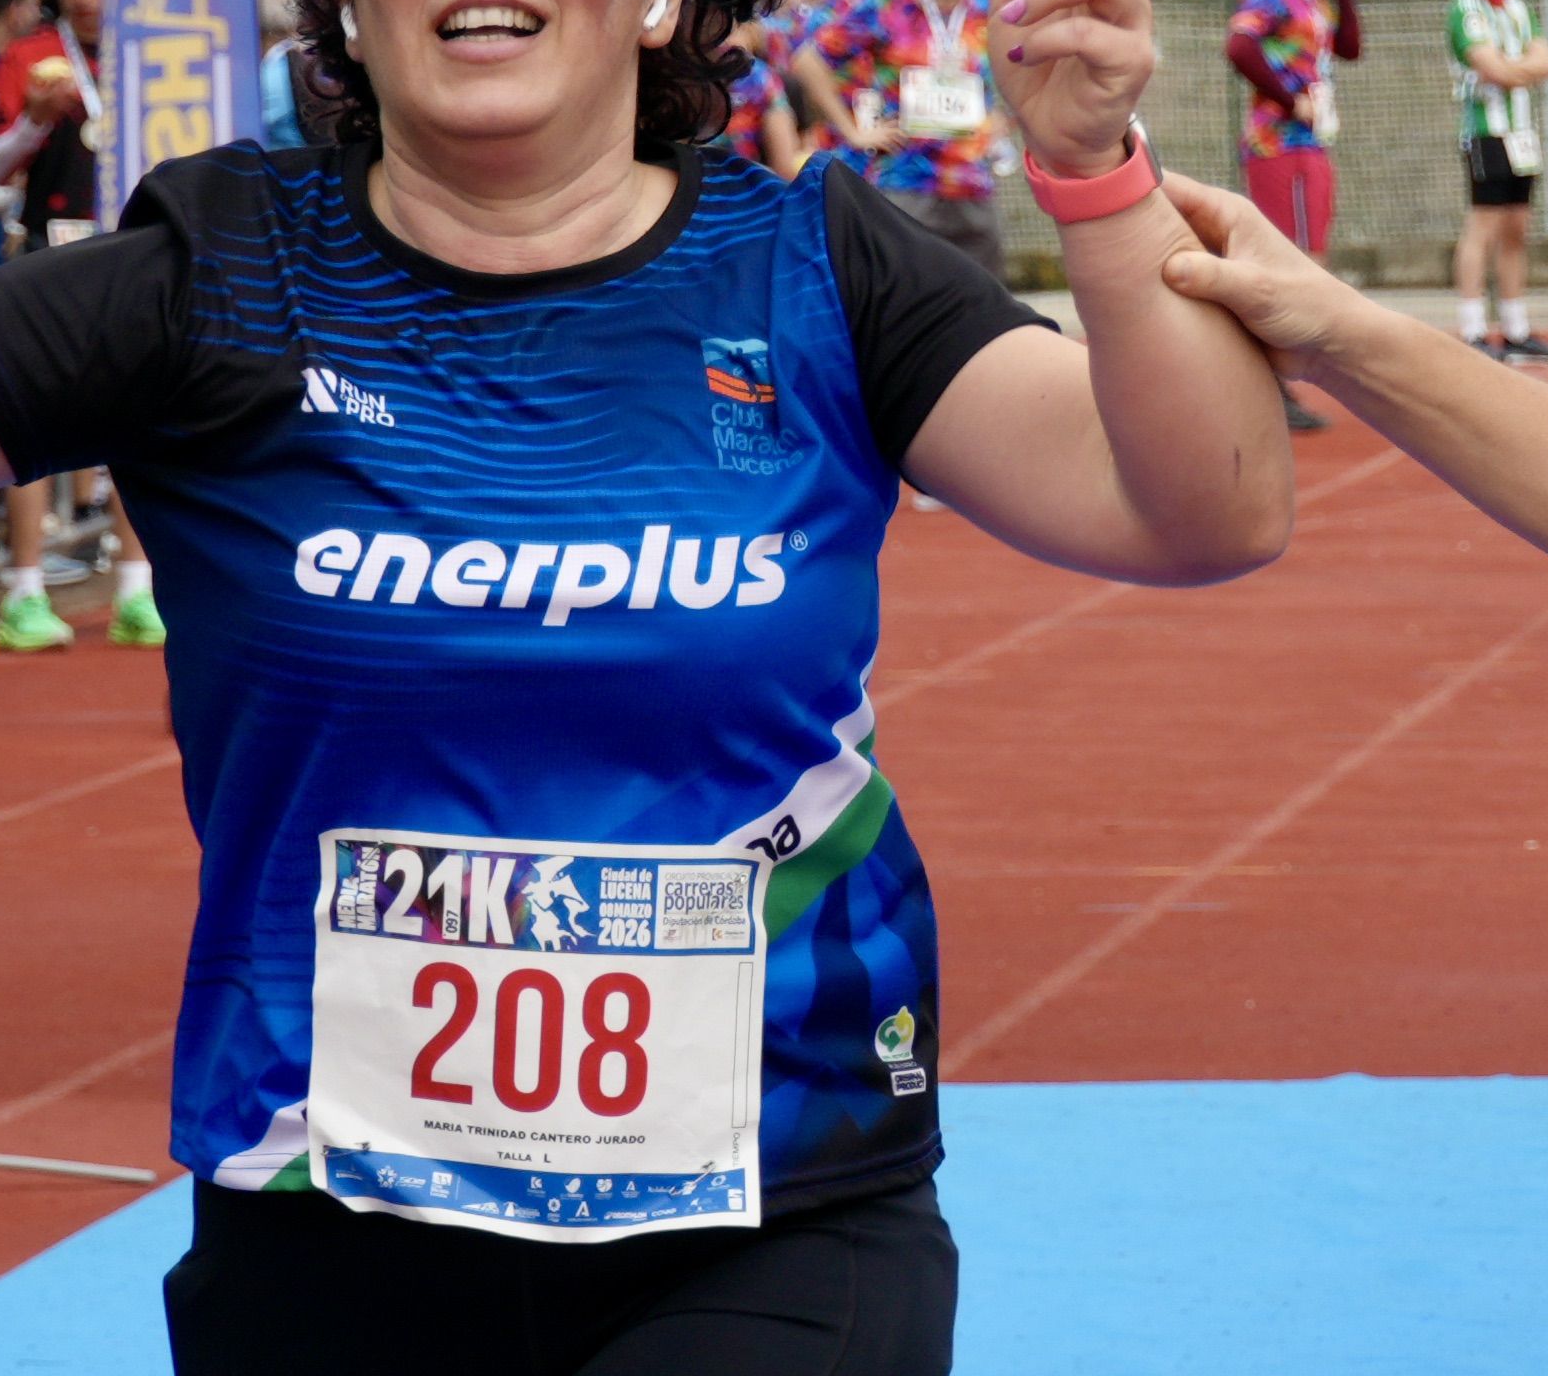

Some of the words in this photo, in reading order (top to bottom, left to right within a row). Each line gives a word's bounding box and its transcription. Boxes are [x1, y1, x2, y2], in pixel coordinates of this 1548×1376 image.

[340, 377, 386, 414] RUN
[346, 397, 395, 427] PRO
[712, 403, 764, 430] Club
[601, 868, 638, 882] Ciudad
[383, 849, 516, 945] 21K
[600, 882, 651, 900] LUCENA
[664, 881, 734, 896] carreras
[663, 891, 744, 914] populares
[597, 918, 651, 947] 2026
[411, 962, 650, 1117] 208
[424, 1120, 462, 1133] MARIA
[467, 1125, 526, 1140] TRINIDAD
[530, 1131, 591, 1144] CANTERO
[595, 1134, 645, 1144] JURADO
[497, 1151, 532, 1162] TALLA
[544, 1153, 551, 1163] L
